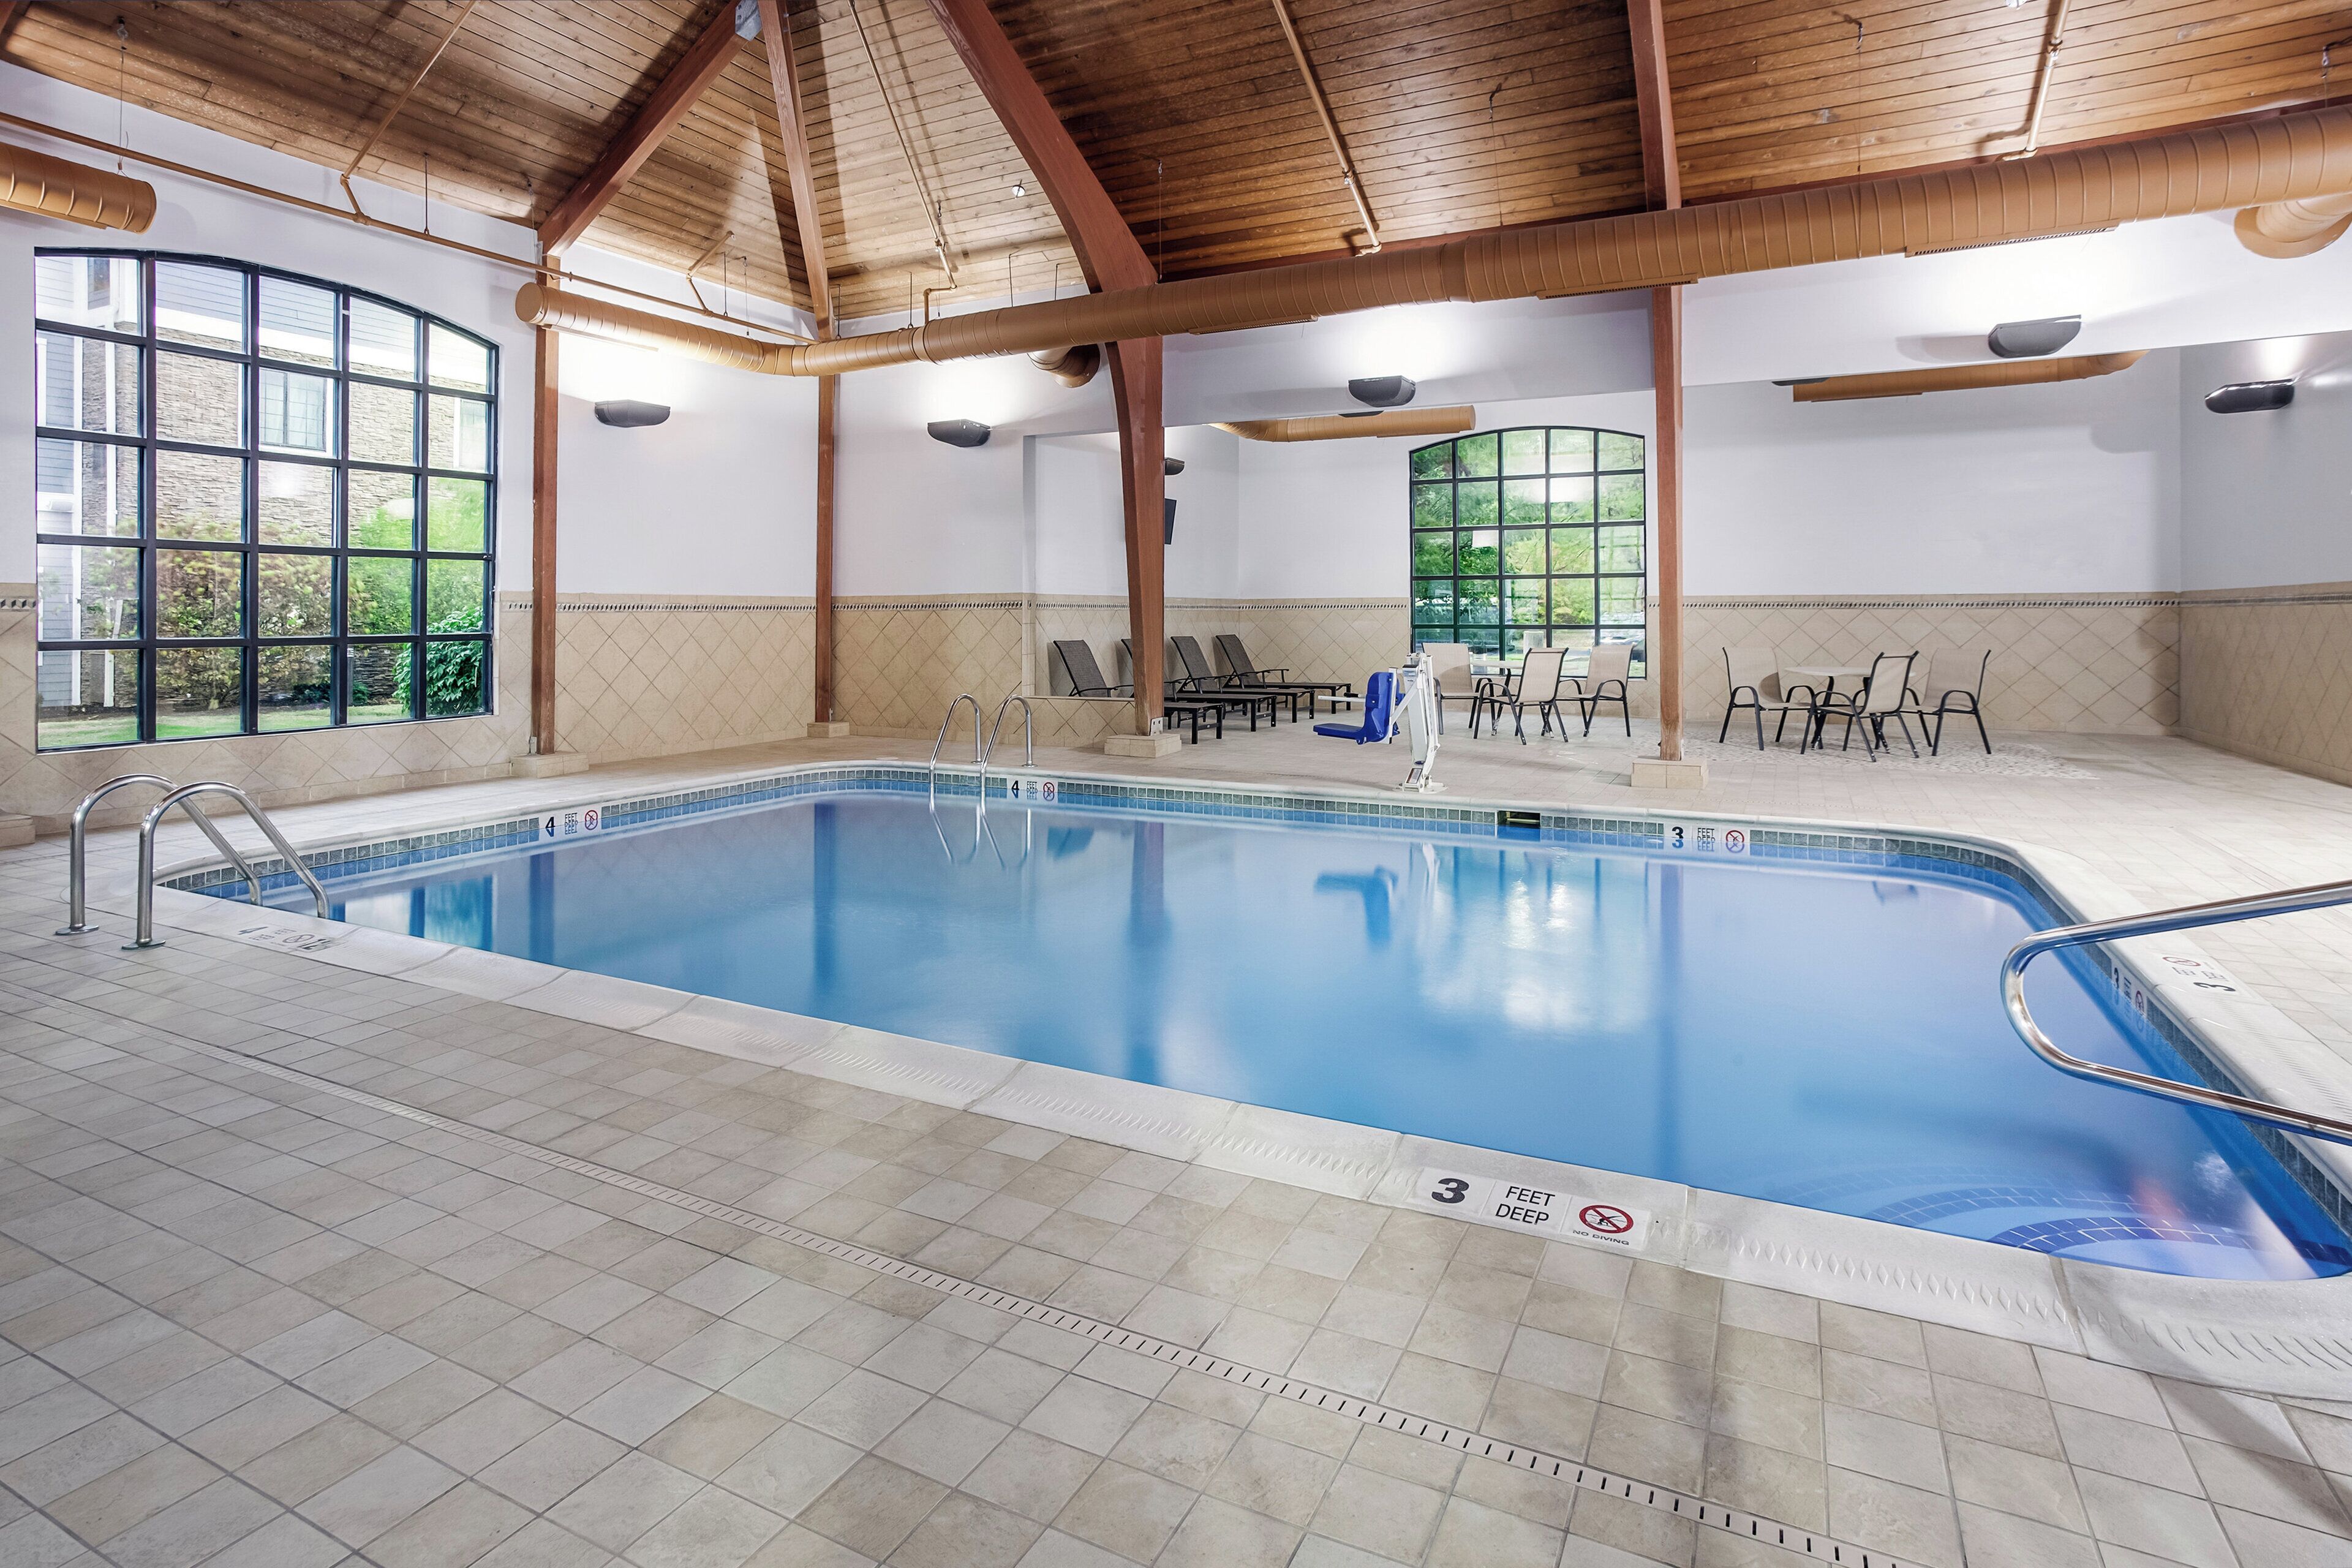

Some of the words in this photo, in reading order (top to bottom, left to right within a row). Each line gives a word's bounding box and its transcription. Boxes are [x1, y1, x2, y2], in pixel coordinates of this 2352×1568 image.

[1011, 780, 1019, 790] 4
[545, 816, 556, 828] 4
[565, 813, 578, 822] FEET
[1672, 826, 1684, 839] 3
[1697, 827, 1714, 837] FEET
[2193, 982, 2236, 991] 3
[1431, 1178, 1469, 1204] 3
[1506, 1186, 1556, 1207] FEET
[1495, 1204, 1549, 1225] DEEP
[1593, 1234, 1629, 1245] DIVING
